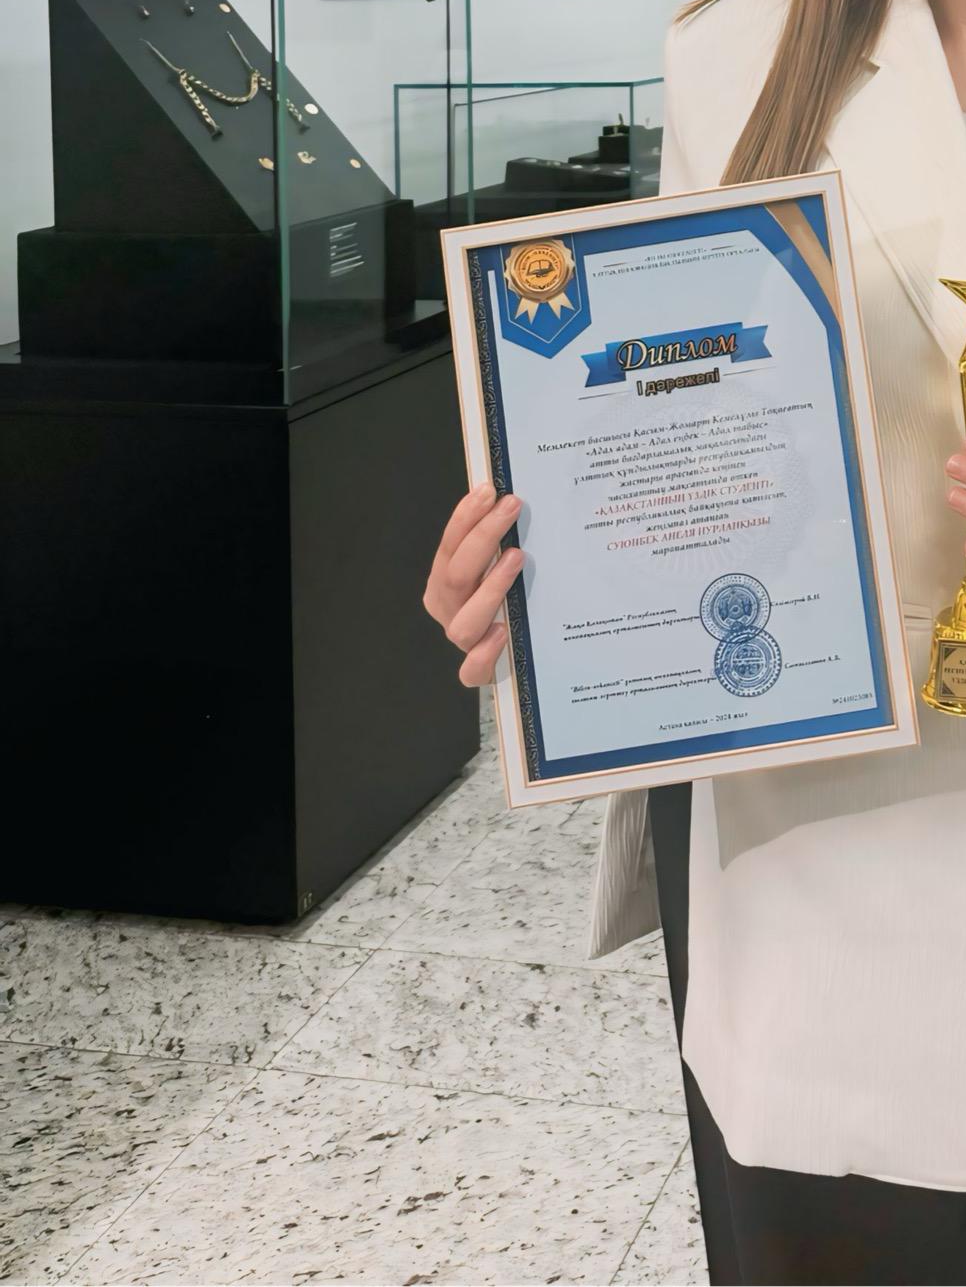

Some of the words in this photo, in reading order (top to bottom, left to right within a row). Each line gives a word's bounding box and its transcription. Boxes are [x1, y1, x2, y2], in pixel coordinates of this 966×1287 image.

[615, 333, 738, 371] Диплом
[645, 367, 720, 395] дәрежелі
[536, 439, 586, 454] Мемлекет
[587, 431, 631, 445] басшысы
[615, 442, 639, 452] адам
[648, 436, 672, 447] Адал
[708, 426, 732, 437] Адал
[589, 458, 620, 469] атты
[583, 519, 614, 531] атты
